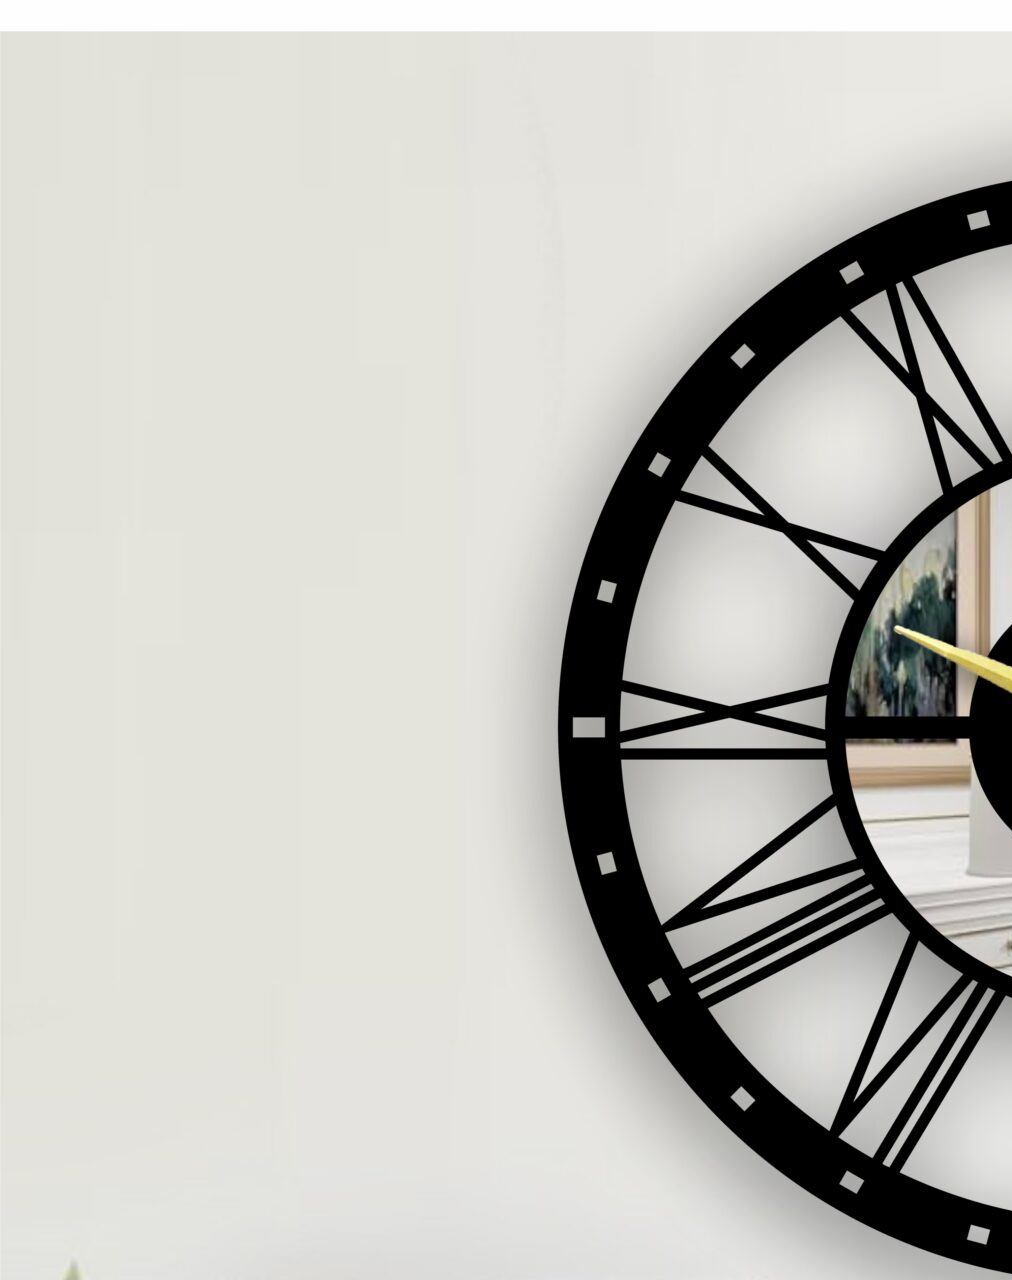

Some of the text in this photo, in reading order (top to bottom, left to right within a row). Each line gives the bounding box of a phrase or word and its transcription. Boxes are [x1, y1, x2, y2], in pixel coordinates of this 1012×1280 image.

[674, 446, 886, 602] X
[620, 680, 828, 760] IX
[661, 793, 894, 1009] VIII
[829, 931, 1006, 1173] VII
